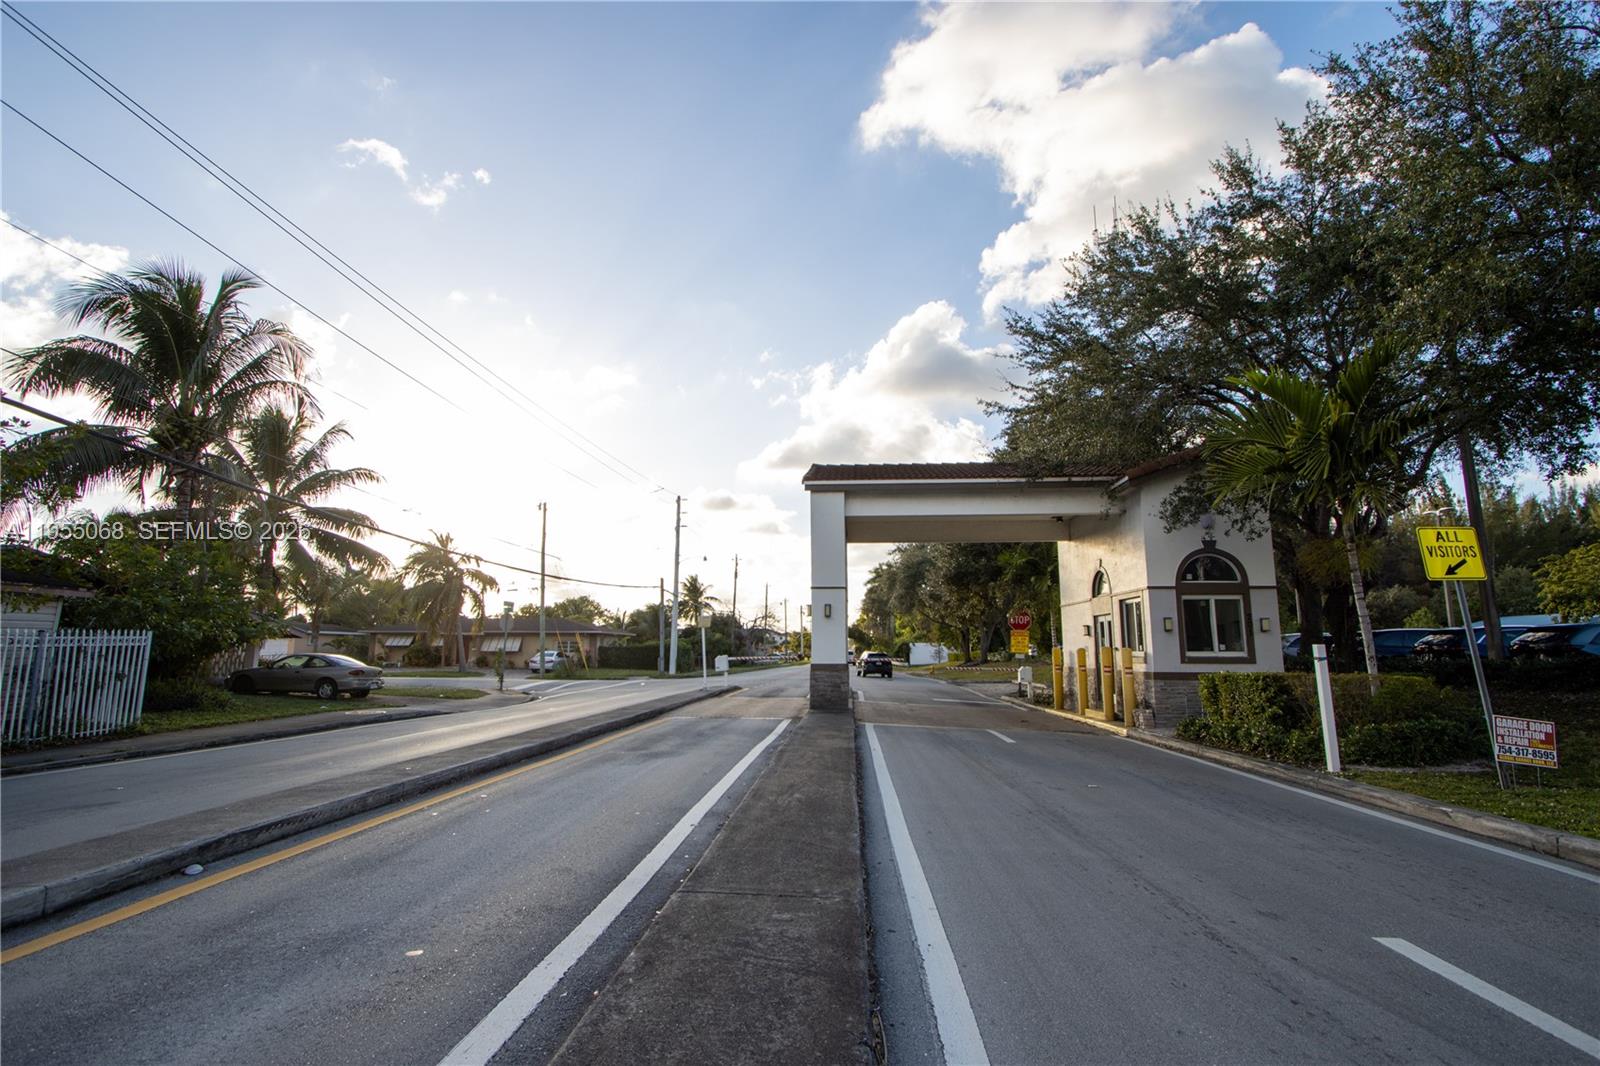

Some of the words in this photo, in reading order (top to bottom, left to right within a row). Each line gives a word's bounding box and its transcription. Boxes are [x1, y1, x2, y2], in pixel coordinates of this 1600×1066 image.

[1436, 530, 1463, 543] ALL
[1426, 545, 1477, 558] VISITORS
[1496, 717, 1528, 730] GARAGE
[1529, 722, 1553, 733] DOOR
[1497, 727, 1545, 741] INSTALLATION
[1504, 736, 1529, 747] REPAIR
[1497, 745, 1555, 760] 754-317-8595
